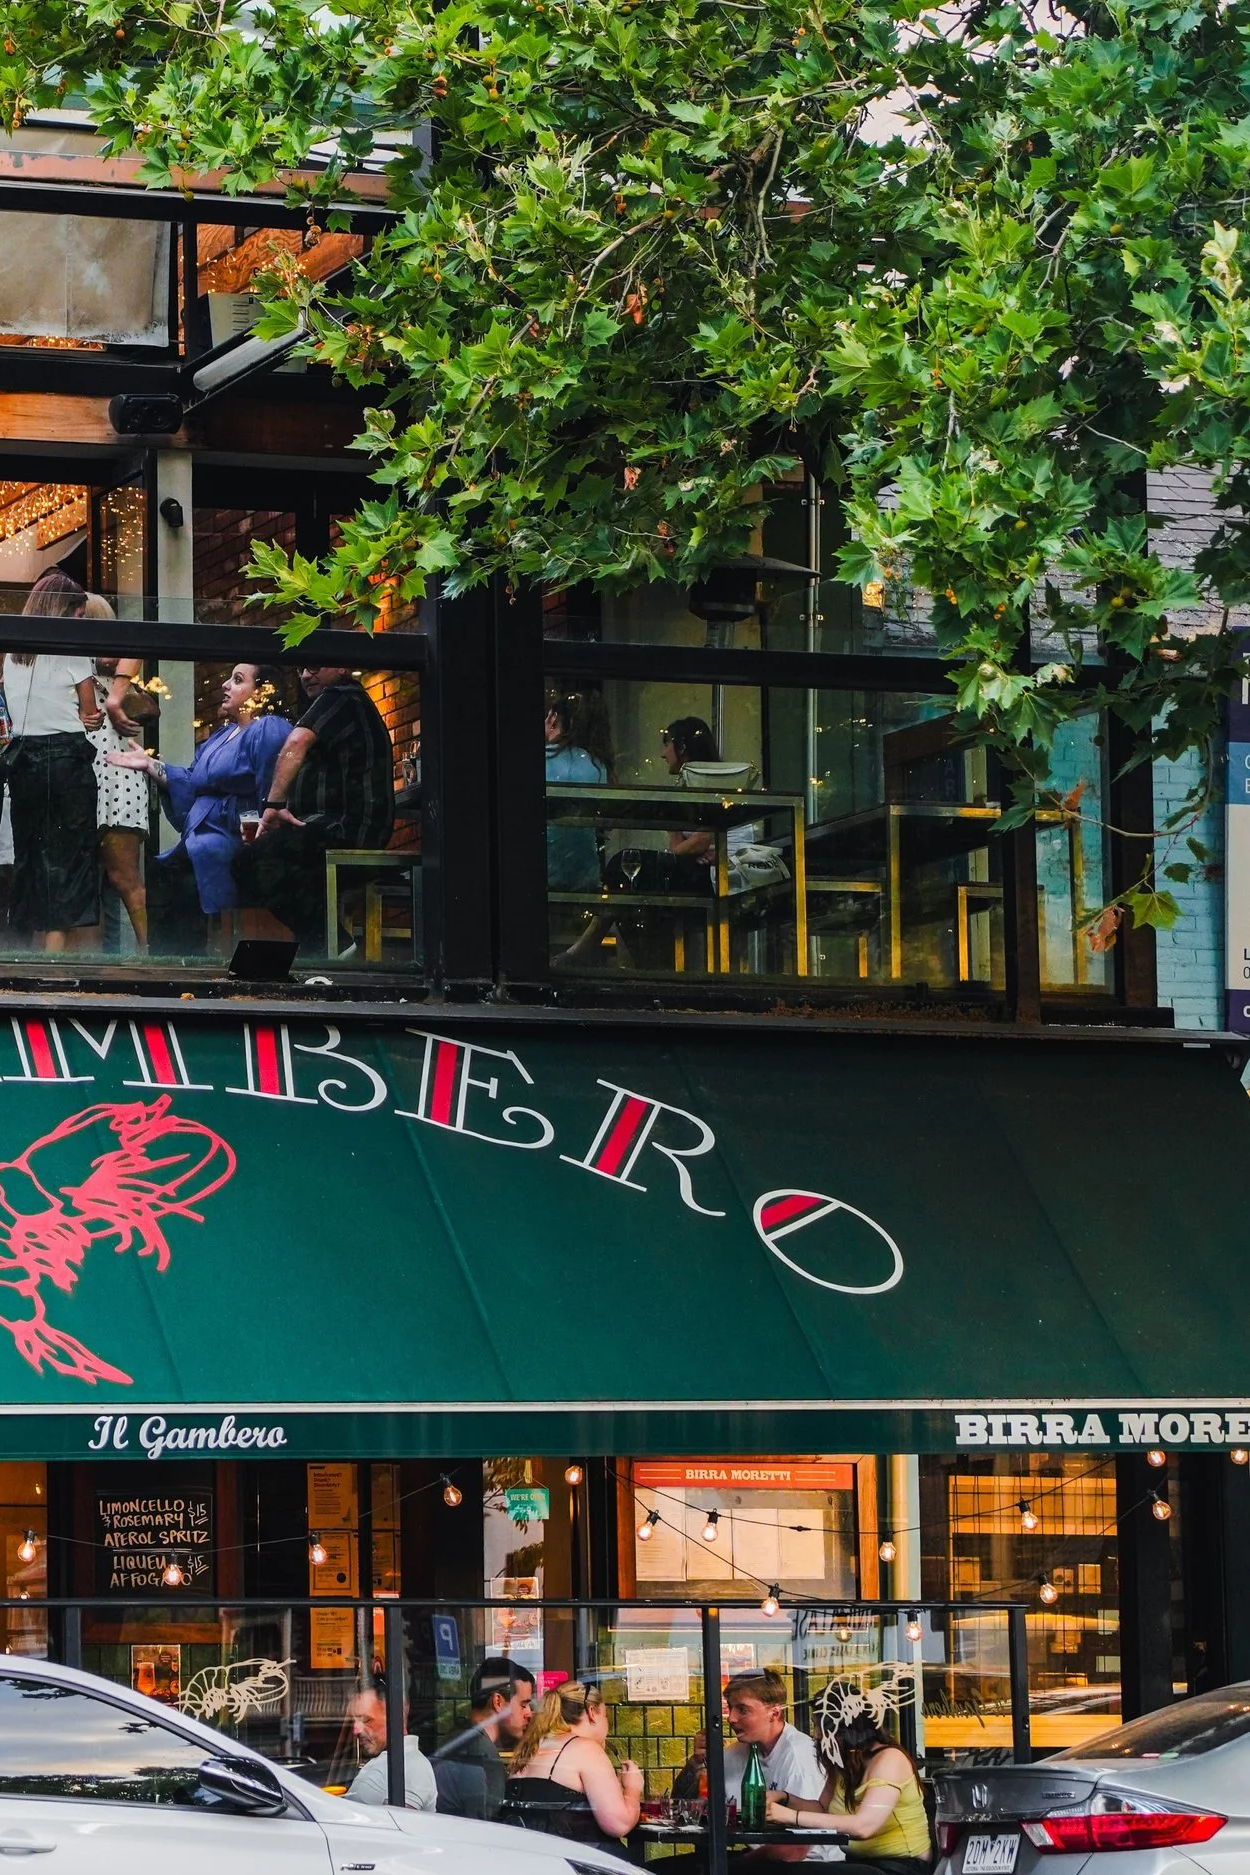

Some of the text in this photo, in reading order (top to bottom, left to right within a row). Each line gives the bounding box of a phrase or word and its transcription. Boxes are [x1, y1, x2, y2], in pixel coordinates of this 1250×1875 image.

[87, 1414, 288, 1460] Il Gambero
[955, 1414, 1110, 1446] BIRRA
[685, 1469, 791, 1481] BIRRA MORETTI
[99, 1499, 208, 1527] LIMONCELLO $15
[113, 1513, 184, 1529] ROSEMARY
[104, 1530, 211, 1548] APEROL SPRITZ
[113, 1555, 184, 1570] LIQUEU
